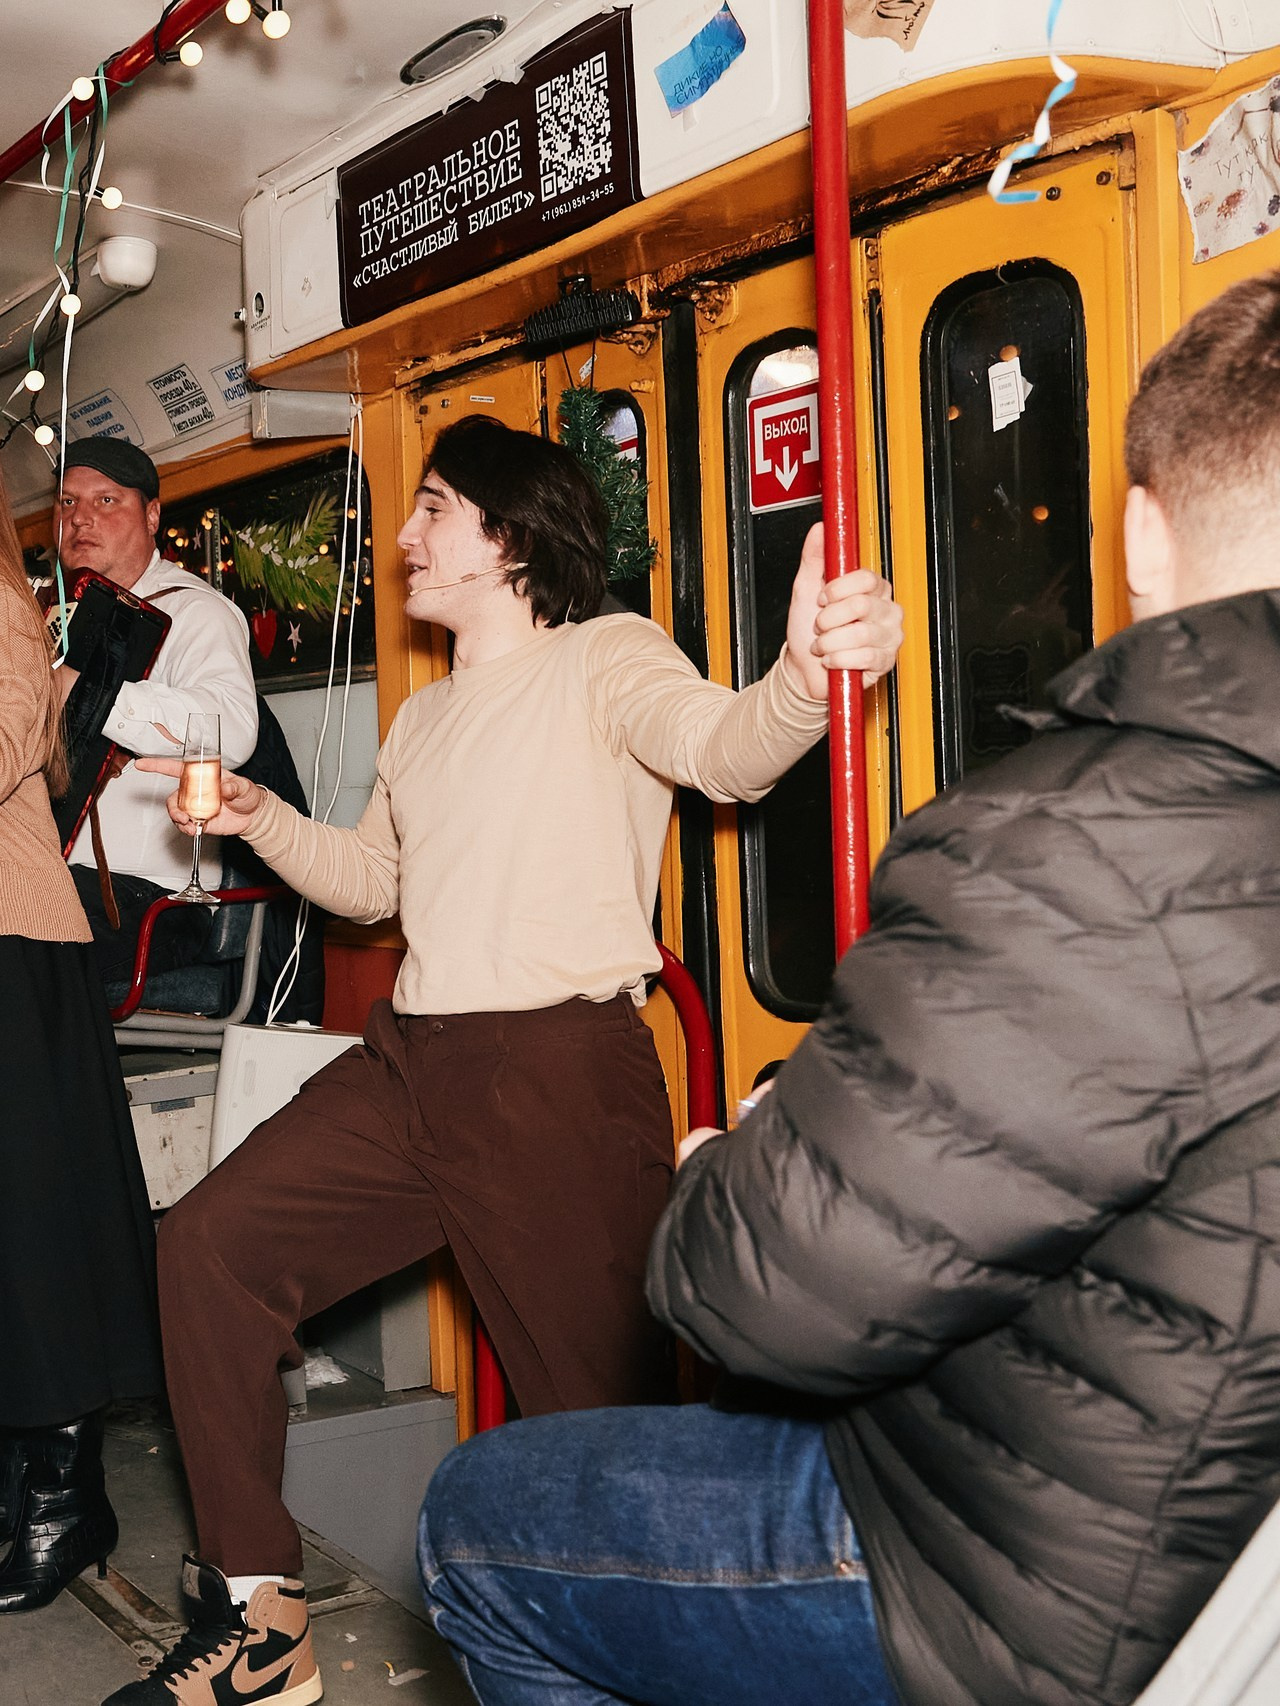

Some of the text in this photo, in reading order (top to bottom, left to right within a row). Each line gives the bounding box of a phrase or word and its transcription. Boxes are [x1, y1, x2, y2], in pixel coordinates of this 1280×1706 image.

[673, 45, 723, 97] ДИКИЕ НО
[358, 119, 521, 229] ТЕАТРАЛЬНОЕ
[359, 150, 523, 258] ПУТЕШЕСТВИЕ
[541, 182, 615, 222] +7(961)854-34-55
[352, 190, 536, 289] «СЧАСТЛИВЫЙ БИЛЕТ»
[152, 369, 187, 390] СТОИМОСТЬ
[159, 386, 185, 403] ПРОЕЗДА
[86, 410, 114, 428] ПАДЕНИЯ
[764, 415, 808, 441] ВЫХОД
